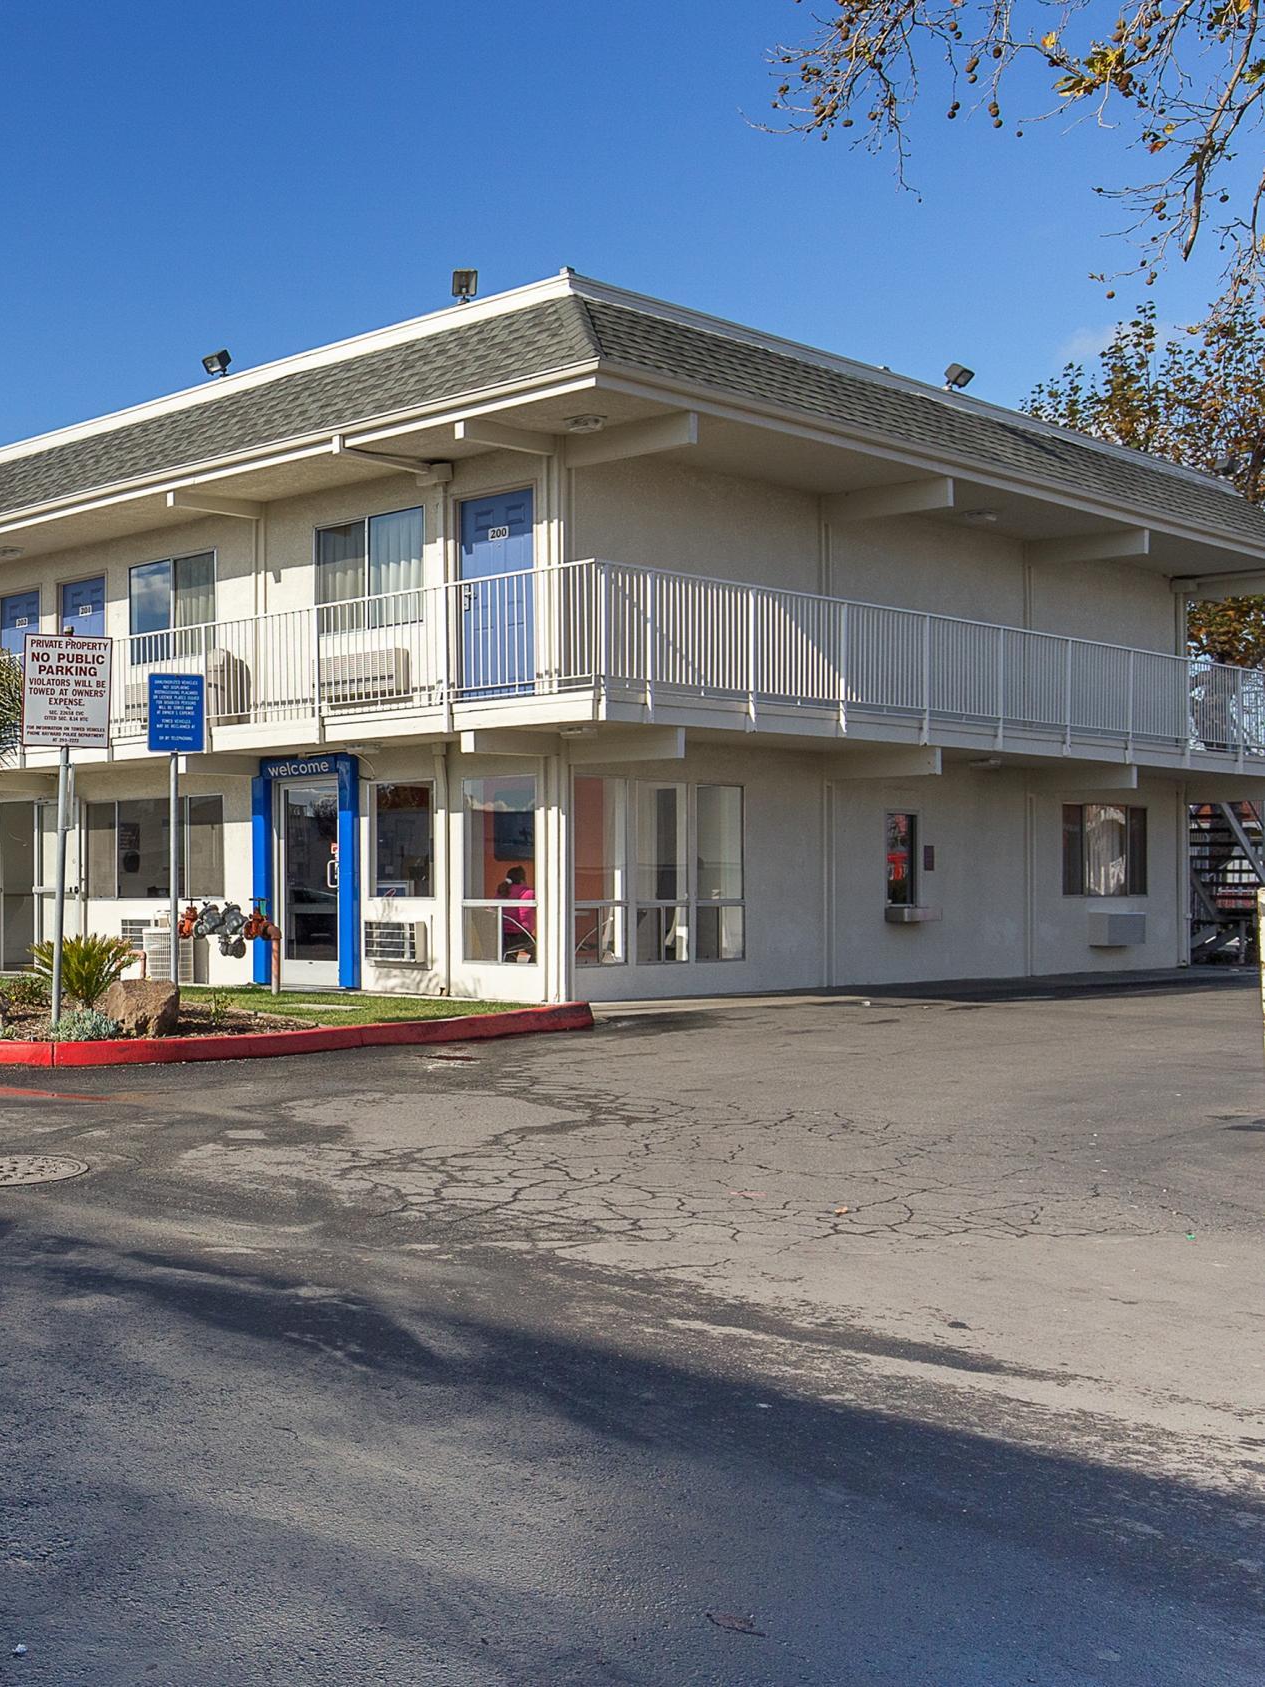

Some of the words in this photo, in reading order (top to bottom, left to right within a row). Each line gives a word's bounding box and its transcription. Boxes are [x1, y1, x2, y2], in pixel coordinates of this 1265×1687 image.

[490, 527, 507, 539] 200
[30, 638, 63, 648] PRIVATE
[65, 640, 108, 651] PROPERTY
[31, 652, 50, 662] NO
[57, 653, 105, 664] PUBLIC
[38, 665, 98, 676] PARKING
[29, 678, 70, 686] VIOLATORS
[74, 680, 92, 688] WILL
[29, 687, 56, 695] TOWED
[72, 688, 106, 698] OWNERS'
[48, 698, 86, 706] EXPENSE.
[268, 761, 329, 777] welcome
